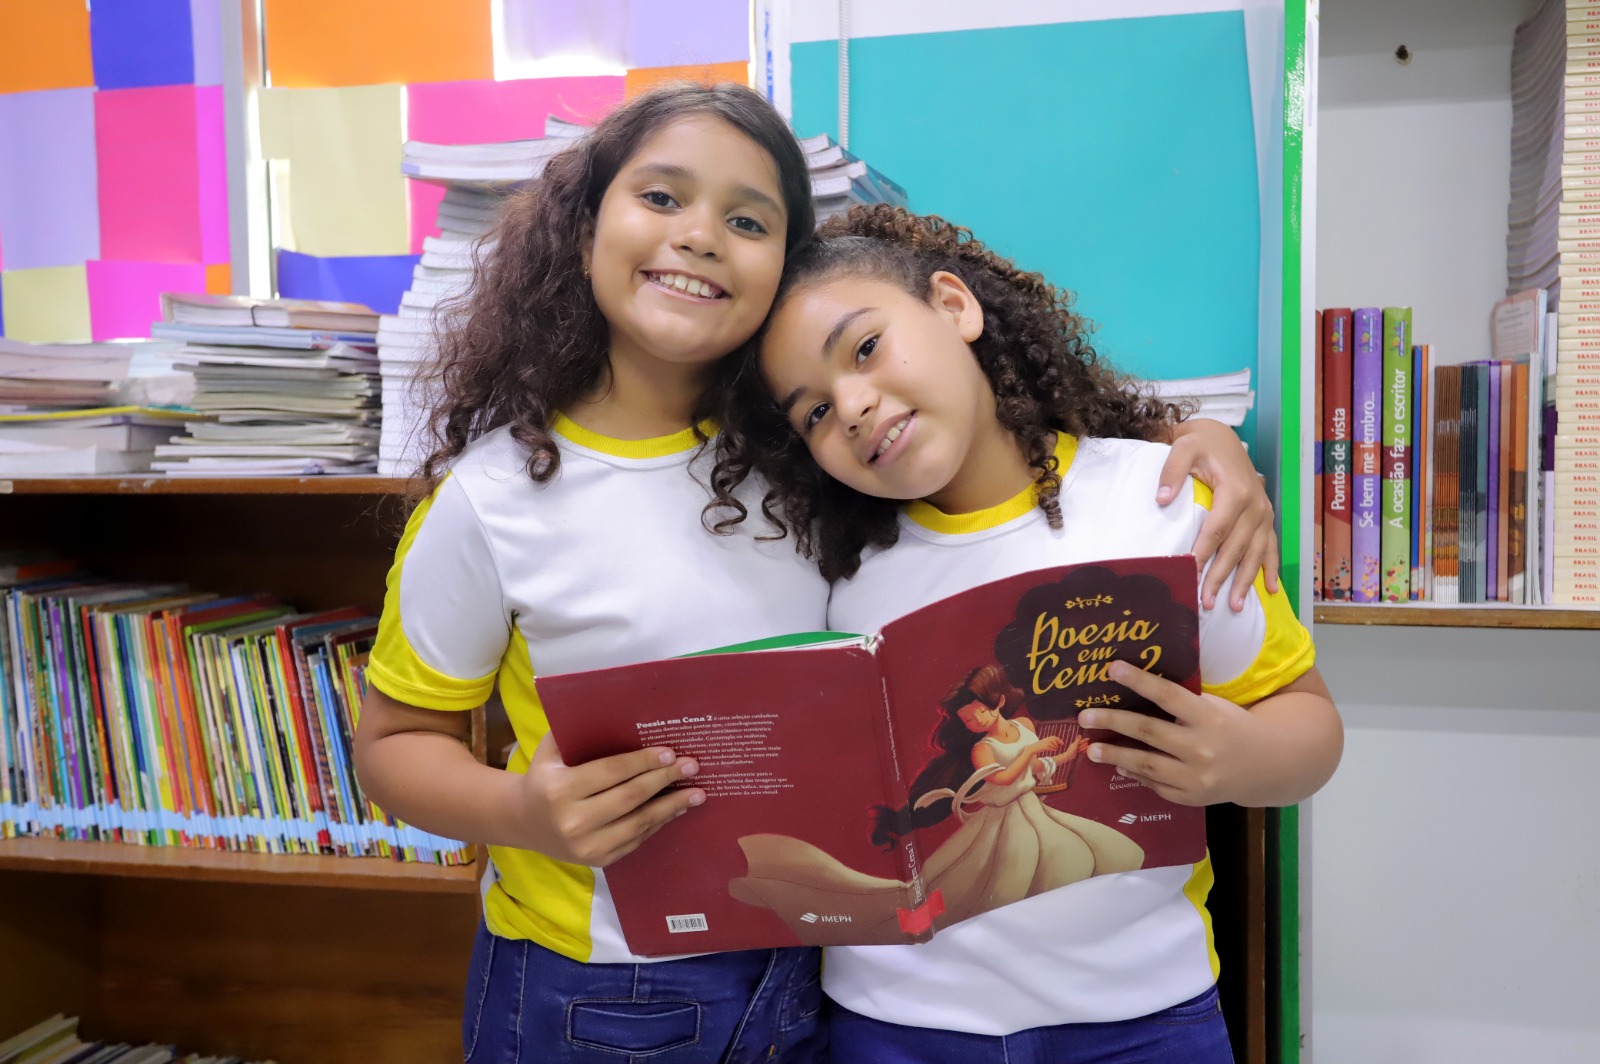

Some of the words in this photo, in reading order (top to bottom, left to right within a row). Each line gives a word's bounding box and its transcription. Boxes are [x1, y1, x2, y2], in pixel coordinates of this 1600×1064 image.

[1390, 368, 1406, 421] escritor
[1330, 407, 1346, 440] vista
[1360, 391, 1375, 449] lembro...
[1394, 423, 1405, 434] o
[1330, 443, 1346, 461] de
[1389, 437, 1405, 459] faz
[1363, 452, 1374, 474] me
[1330, 463, 1346, 511] Pontos
[1359, 478, 1374, 507] bem
[1389, 461, 1405, 513] ocasião
[1358, 511, 1374, 528] Se
[1388, 516, 1404, 529] A
[1025, 609, 1160, 671] Poesia
[1077, 646, 1118, 663] em
[1140, 645, 1163, 678] 2
[636, 719, 666, 729] Poesia
[1140, 813, 1172, 823] IMEPH
[905, 841, 913, 850] 2
[908, 848, 916, 868] Cena
[911, 866, 918, 880] em
[913, 879, 921, 904] Poesia
